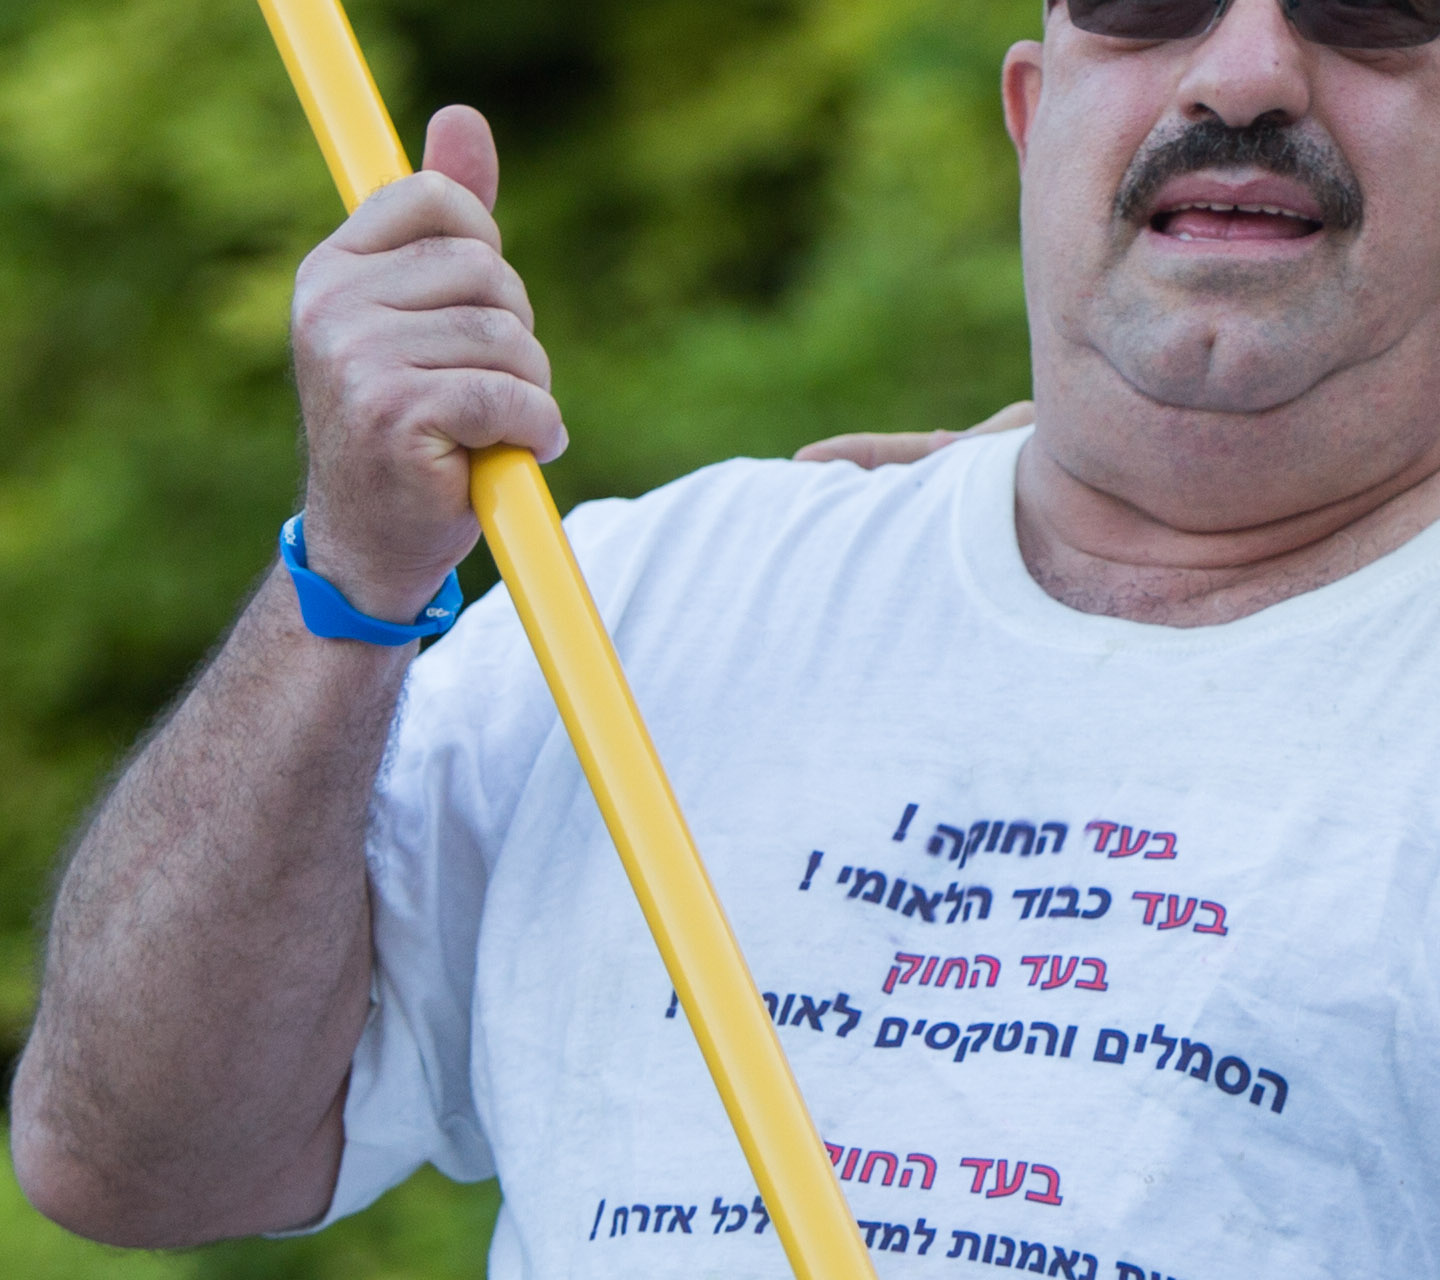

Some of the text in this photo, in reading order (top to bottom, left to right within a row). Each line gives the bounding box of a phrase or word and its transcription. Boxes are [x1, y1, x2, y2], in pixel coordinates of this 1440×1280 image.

[926, 820, 1069, 870] החוקה
[1084, 819, 1178, 860] בעד
[836, 865, 994, 924] הלאומי
[1012, 884, 1112, 920] כבוד
[1131, 890, 1229, 937] בעד
[881, 951, 1109, 996] בעד החוק
[873, 1016, 1079, 1063] והטקסים
[1092, 1023, 1289, 1114] הסמלים
[959, 1157, 1064, 1206] בעד
[609, 1203, 698, 1238] אזרח
